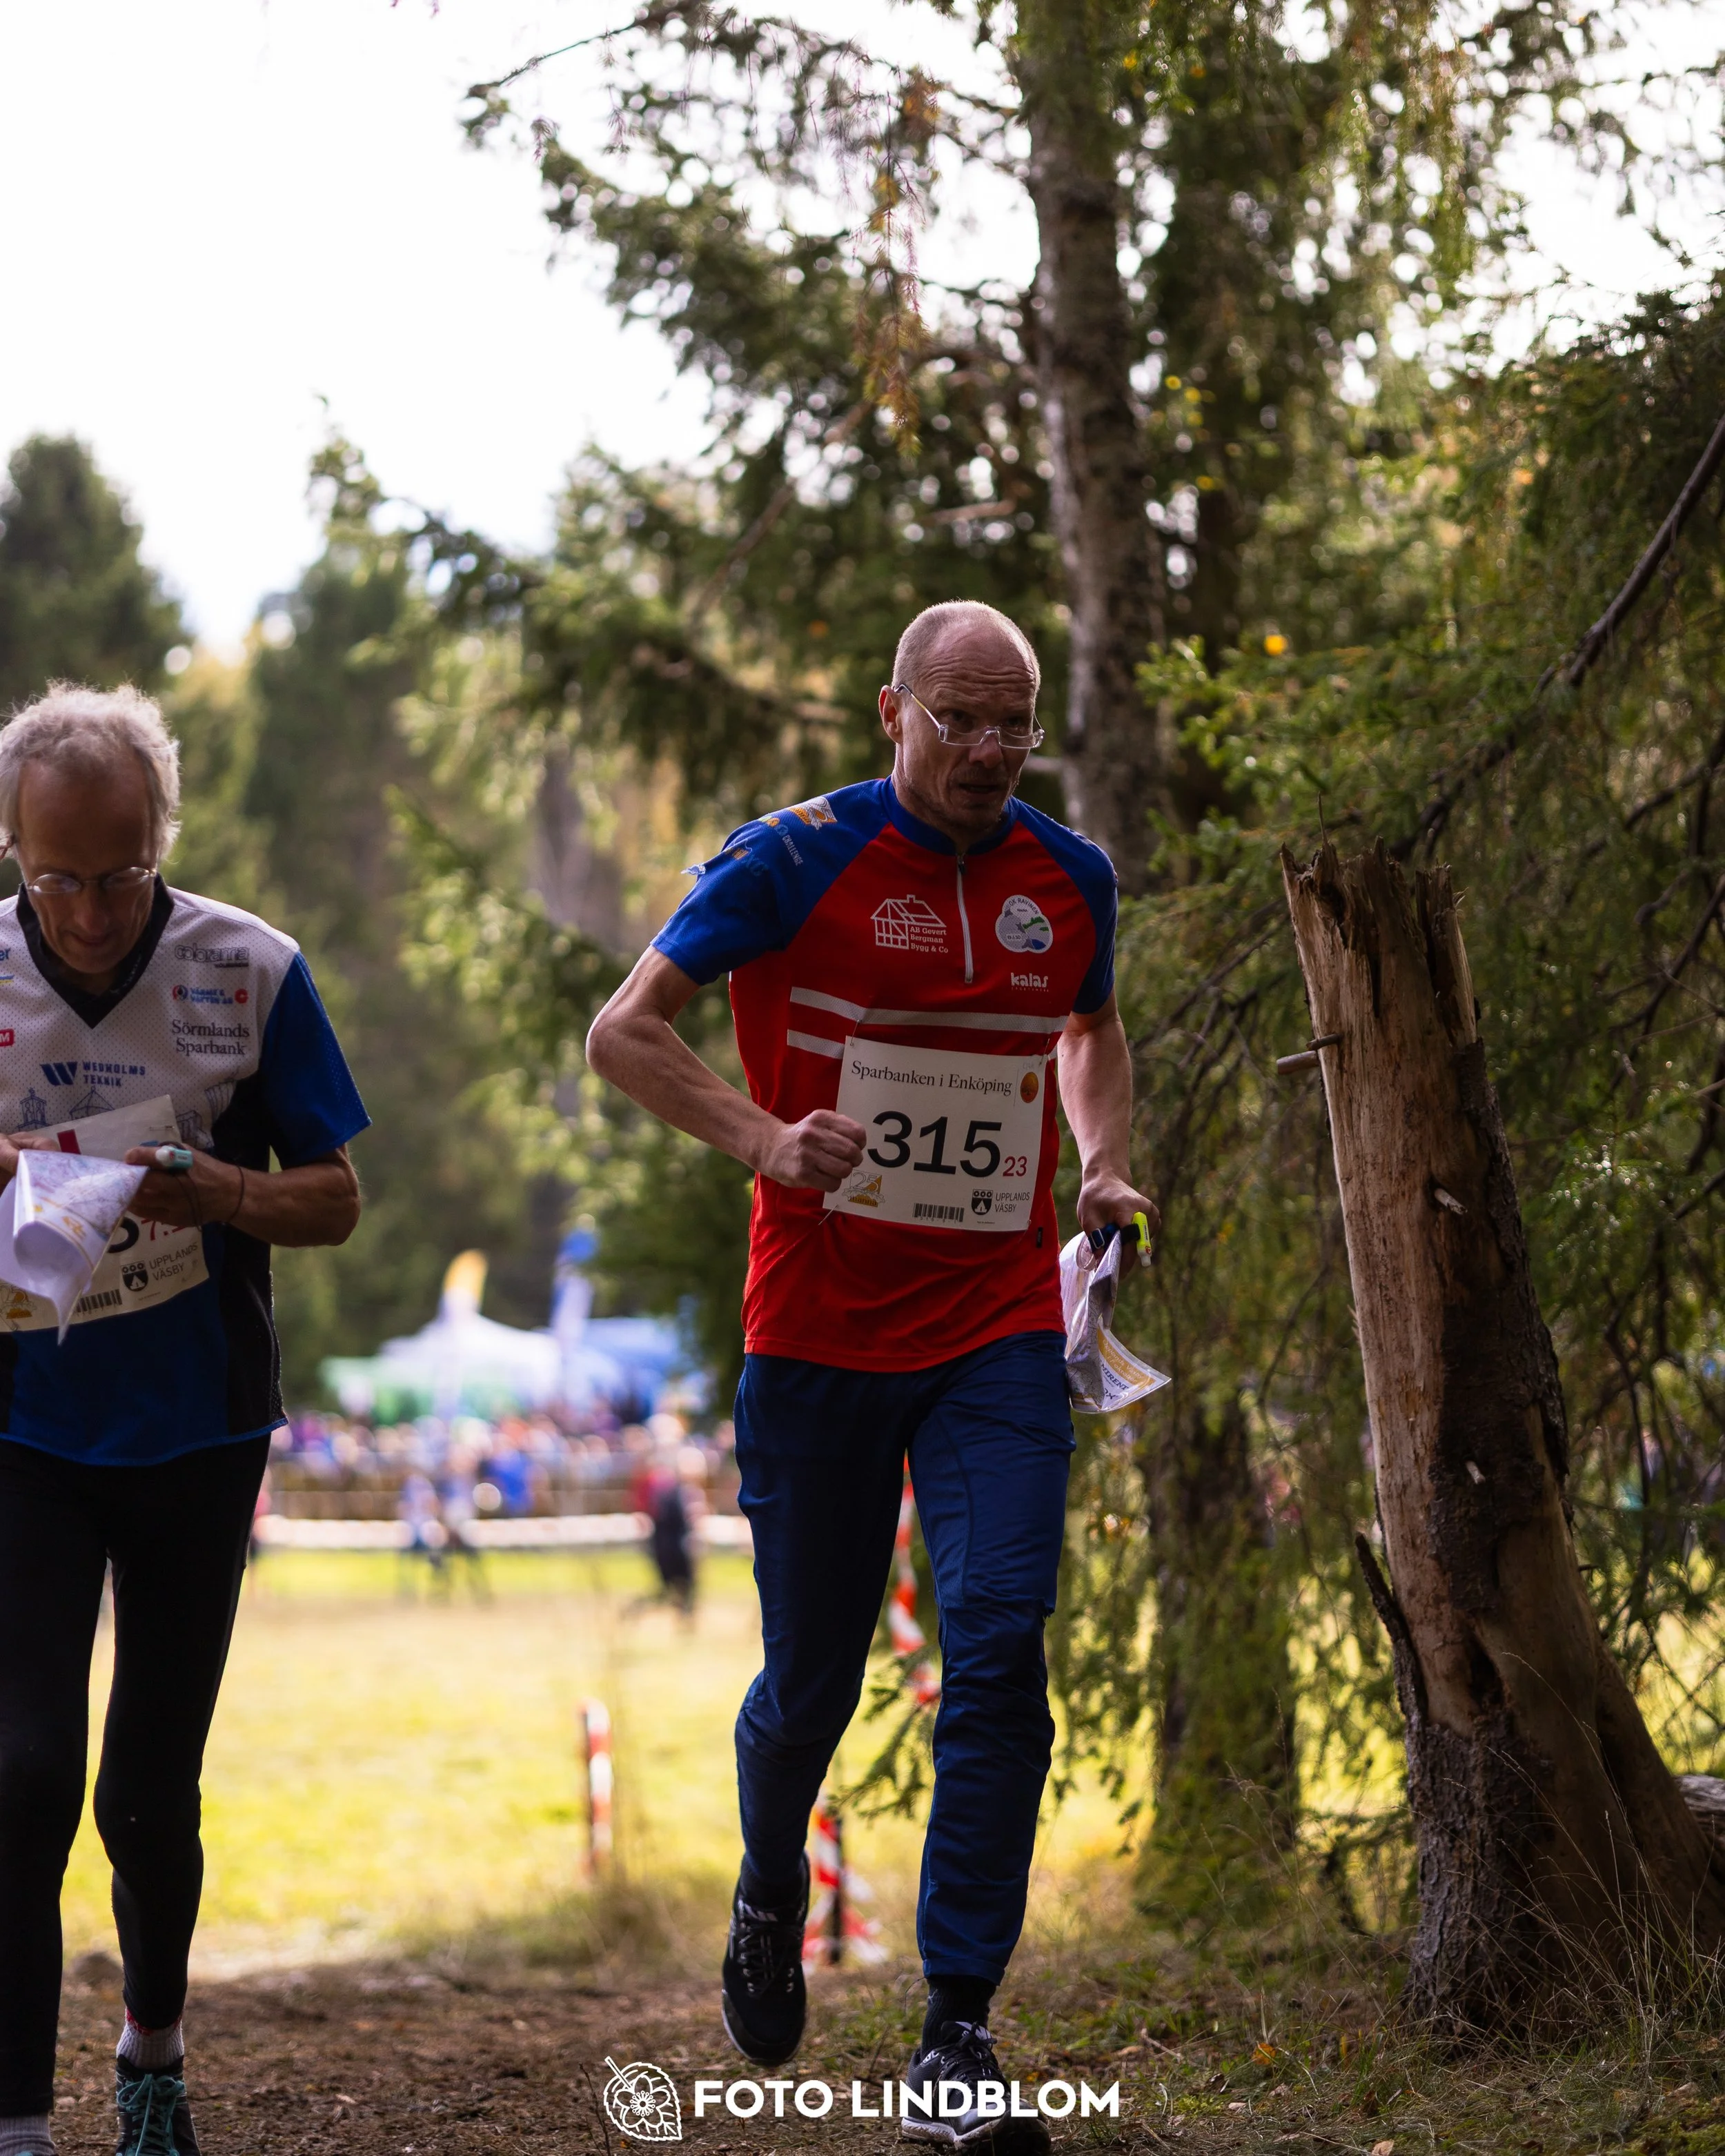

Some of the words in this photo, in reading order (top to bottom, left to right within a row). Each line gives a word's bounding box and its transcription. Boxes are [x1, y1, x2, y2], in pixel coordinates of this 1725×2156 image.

[782, 835, 804, 867] CHALLENGE
[910, 933, 943, 943] Bergman
[922, 927, 947, 936] Gevert
[911, 942, 929, 952] Bygg
[1010, 972, 1048, 988] kalas
[172, 1019, 250, 1038] Sörmlands
[176, 1038, 246, 1056] Sparbank
[83, 1074, 122, 1087] TEKNIK
[851, 1060, 935, 1087] Sparbanken
[939, 1073, 944, 1087] i
[947, 1073, 1013, 1097] Enköping
[867, 1111, 1002, 1178] 315
[1003, 1156, 1027, 1177] 23
[852, 1171, 879, 1191] 25
[995, 1191, 1030, 1202] UPPLANDS
[994, 1202, 1016, 1213] VÄSBY
[149, 1242, 198, 1269] UPPLANDS
[152, 1263, 185, 1280] VÄSBY
[1101, 1360, 1129, 1389] MIRENT
